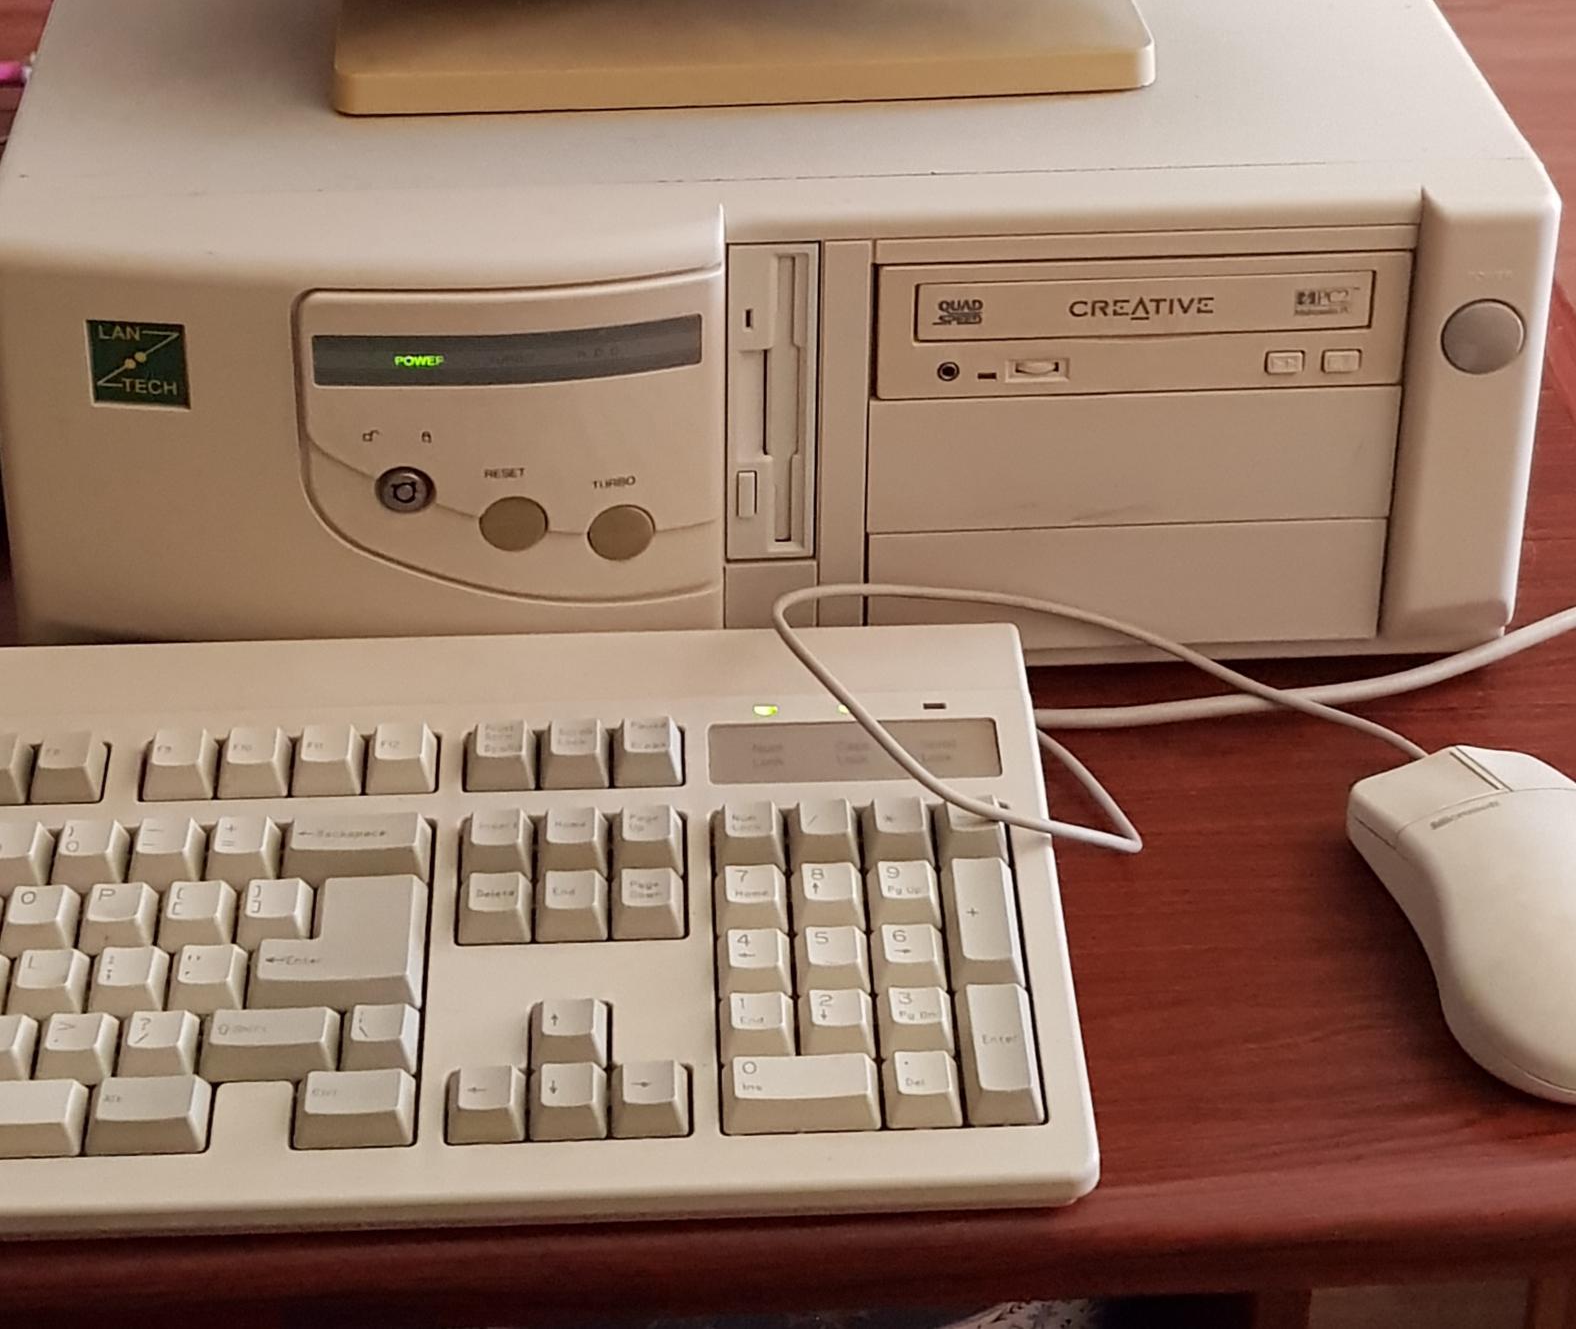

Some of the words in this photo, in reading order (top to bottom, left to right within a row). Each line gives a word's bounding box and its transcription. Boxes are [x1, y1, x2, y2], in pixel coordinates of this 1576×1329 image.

[938, 299, 984, 314] QUAD
[1069, 297, 1215, 320] CREATIVE
[98, 325, 140, 341] LAN
[394, 354, 445, 368] POWER
[121, 378, 178, 395] TECH
[484, 467, 525, 479] RESET
[593, 475, 636, 489] TURBO
[736, 870, 749, 882] 7
[811, 868, 825, 881] 8
[886, 866, 901, 880] 9
[99, 888, 116, 901] P
[736, 933, 751, 947] 4
[815, 931, 829, 944] 5
[892, 929, 907, 943] 6
[819, 994, 834, 1007] 2
[898, 992, 913, 1005] 3
[981, 1034, 1019, 1044] Enter
[741, 1060, 758, 1075] 0
[905, 1078, 926, 1087] Del
